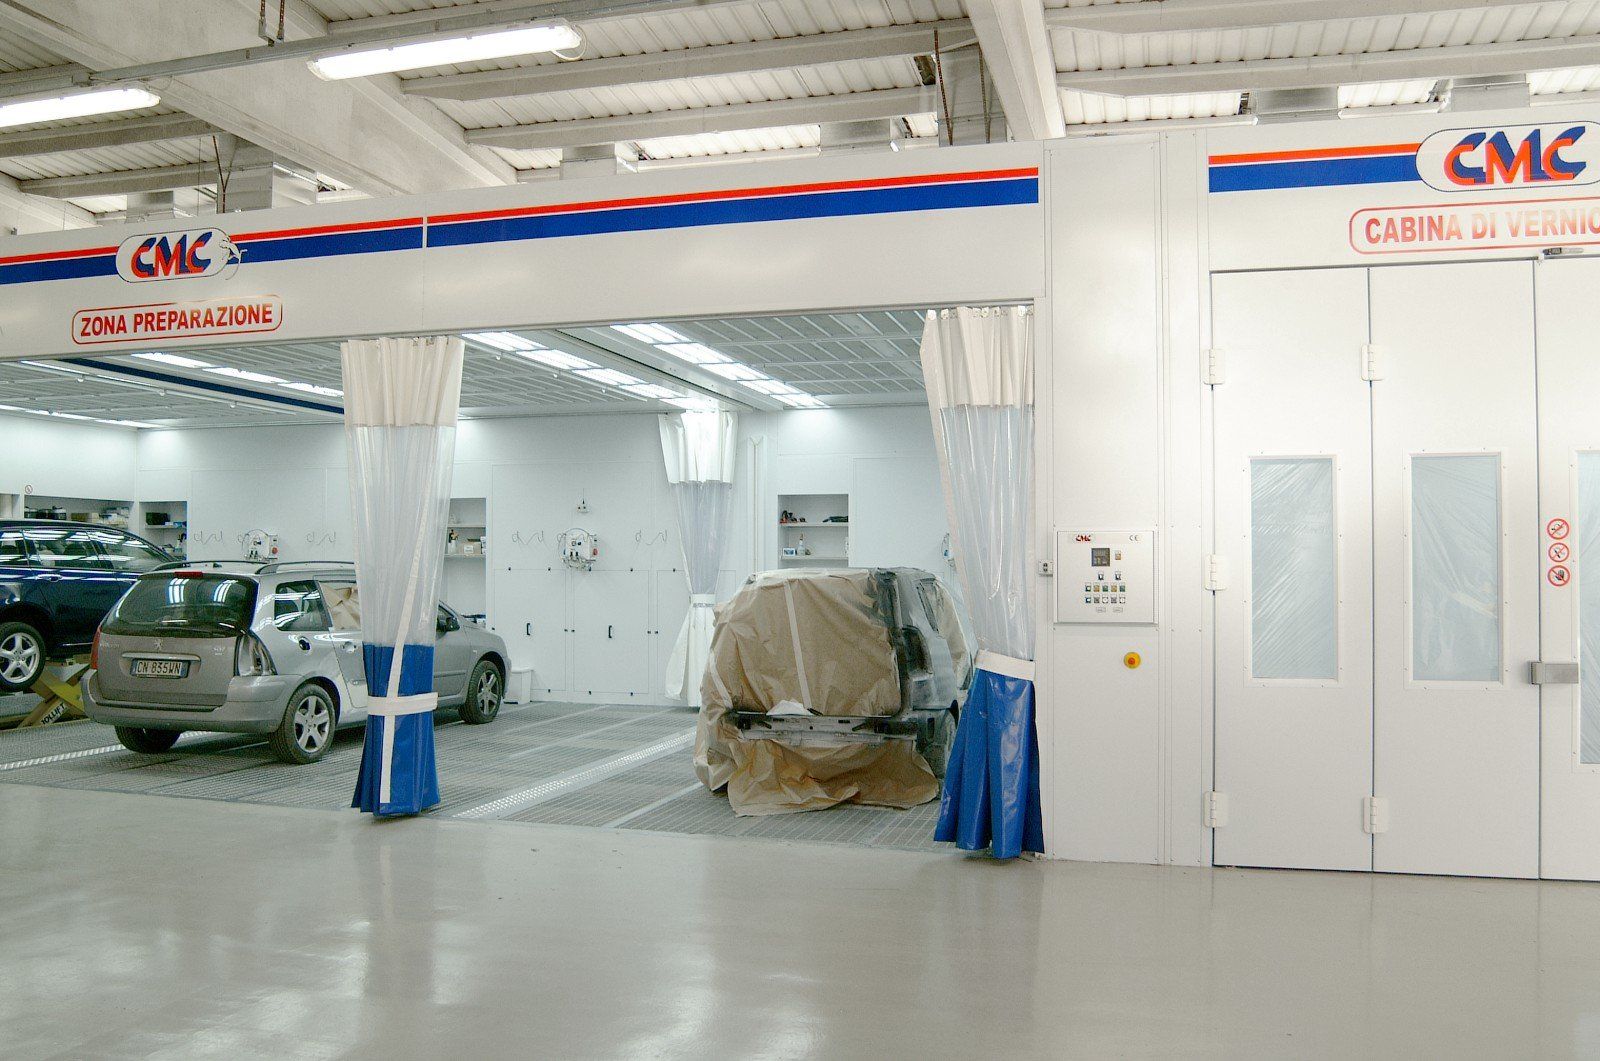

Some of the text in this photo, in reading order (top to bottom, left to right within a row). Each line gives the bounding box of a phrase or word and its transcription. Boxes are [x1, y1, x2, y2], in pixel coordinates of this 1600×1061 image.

[1443, 126, 1587, 185] CMC
[1365, 214, 1464, 244] CABINA
[1472, 211, 1496, 239] DI
[131, 231, 213, 278] CMC
[80, 303, 273, 337] ZONA PREPARAZIONE
[137, 661, 149, 673] CN
